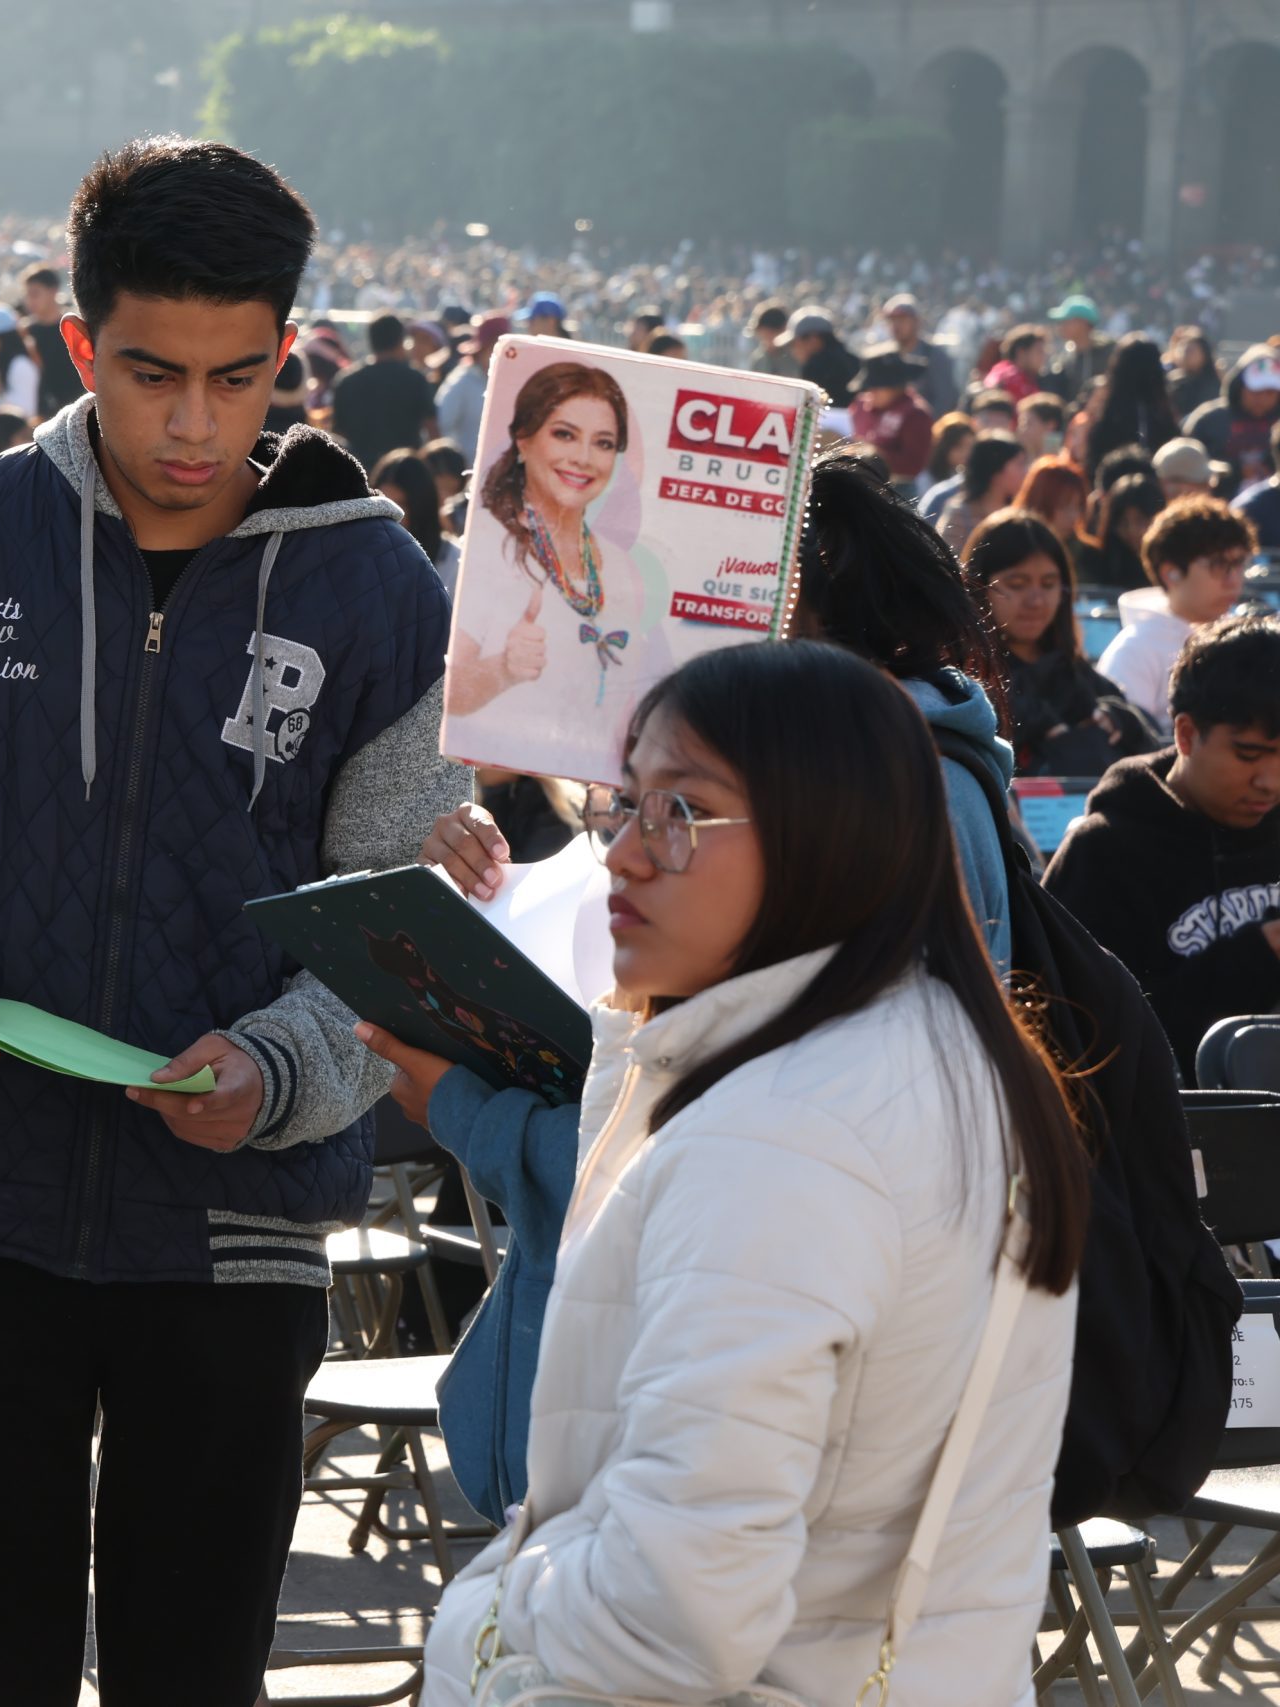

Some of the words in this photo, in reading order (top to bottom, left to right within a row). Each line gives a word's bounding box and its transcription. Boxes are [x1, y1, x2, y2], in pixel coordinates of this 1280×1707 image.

[675, 398, 791, 456] CLA
[678, 454, 782, 486] BRUG
[666, 482, 718, 503] JEFA
[725, 491, 754, 509] DE
[703, 579, 743, 598] QUE
[673, 598, 771, 625] TRANSFOR
[287, 715, 304, 734] 68
[1230, 1398, 1253, 1409] 175
